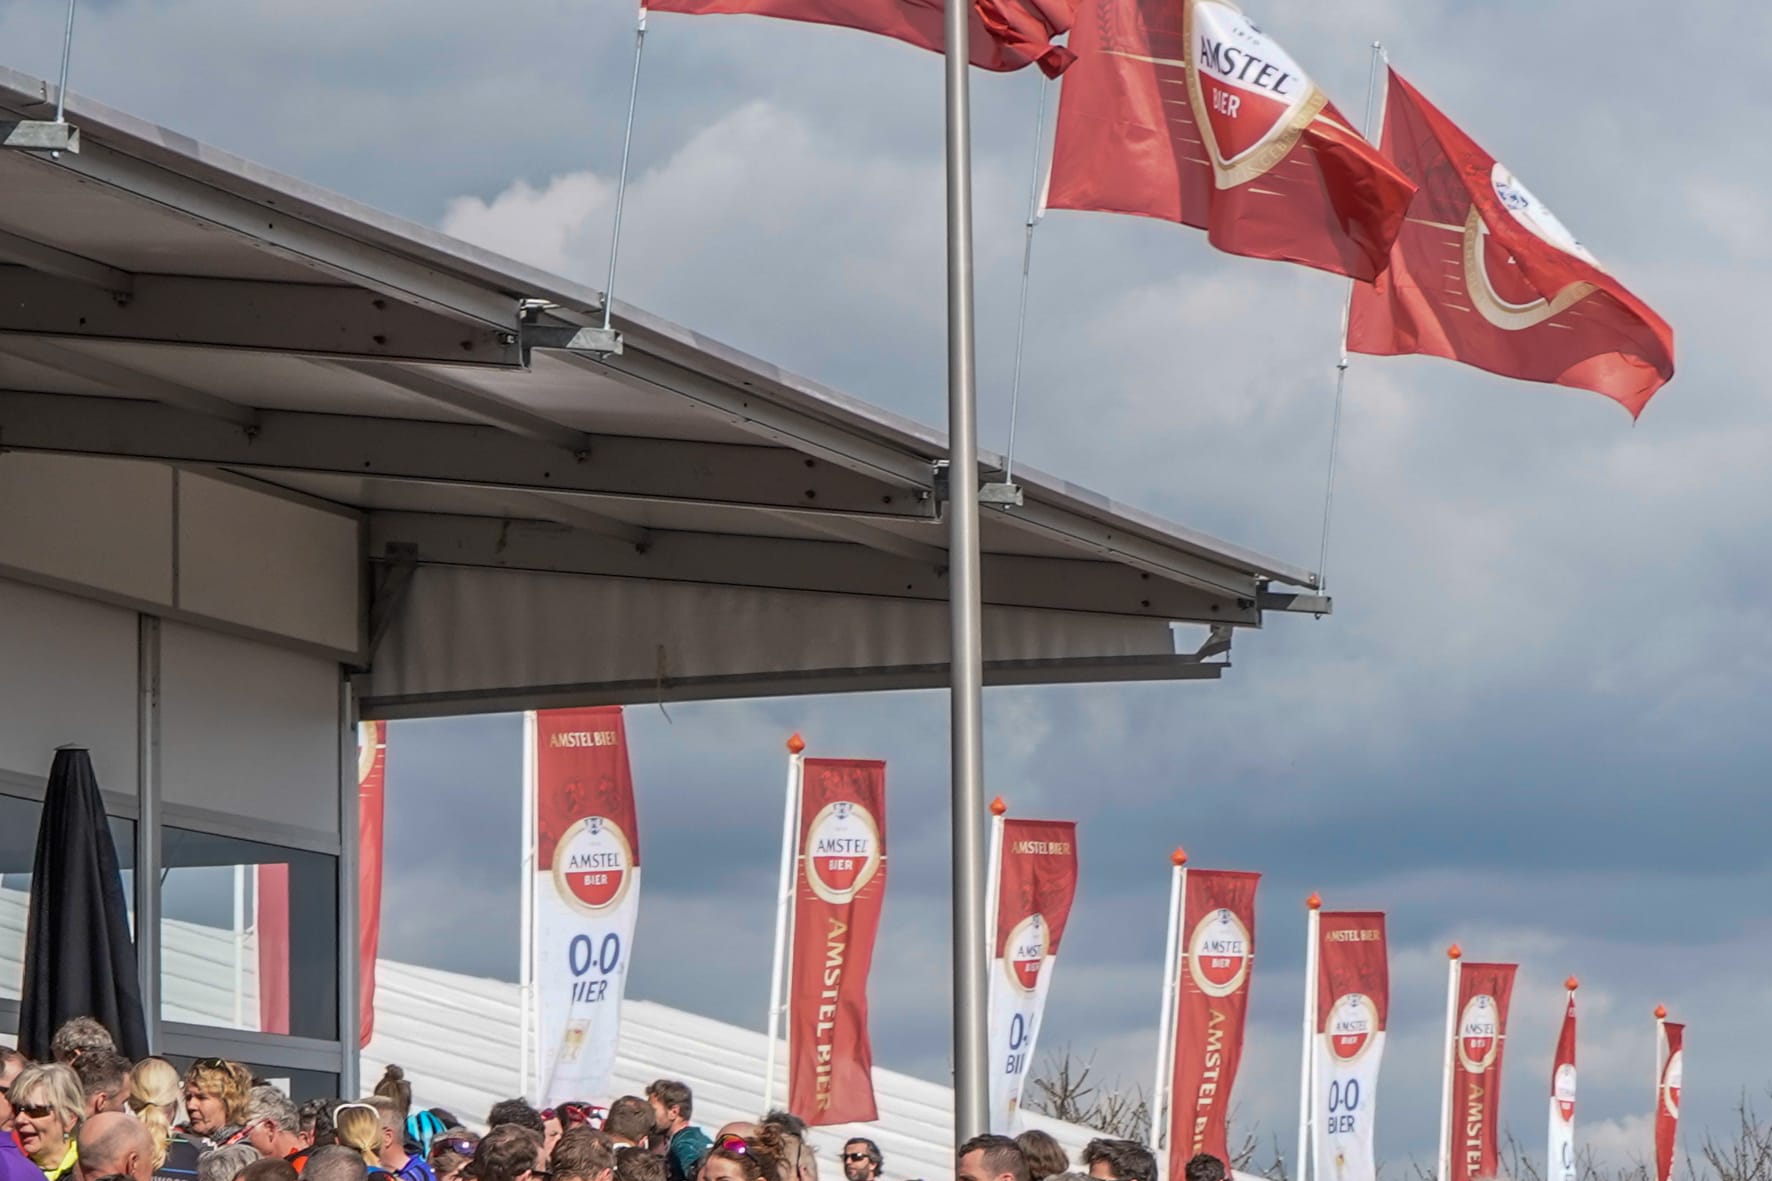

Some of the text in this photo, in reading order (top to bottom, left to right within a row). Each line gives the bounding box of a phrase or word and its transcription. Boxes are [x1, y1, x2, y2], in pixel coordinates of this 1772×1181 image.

[1200, 36, 1291, 95] AMSTEL
[550, 731, 617, 748] AMSTEL BIER
[1012, 840, 1048, 856] AMSTEL
[569, 853, 621, 869] AMSTEL
[828, 858, 853, 871] BIER
[583, 873, 608, 886] BIER
[1325, 929, 1380, 942] AMSTEL BIER
[1203, 940, 1243, 954] AMSTEL
[816, 917, 848, 1037] AMSTEL
[1196, 1009, 1226, 1112] AMSTEL
[1328, 1115, 1355, 1134] BIER
[1466, 1083, 1485, 1177] AMSTEL
